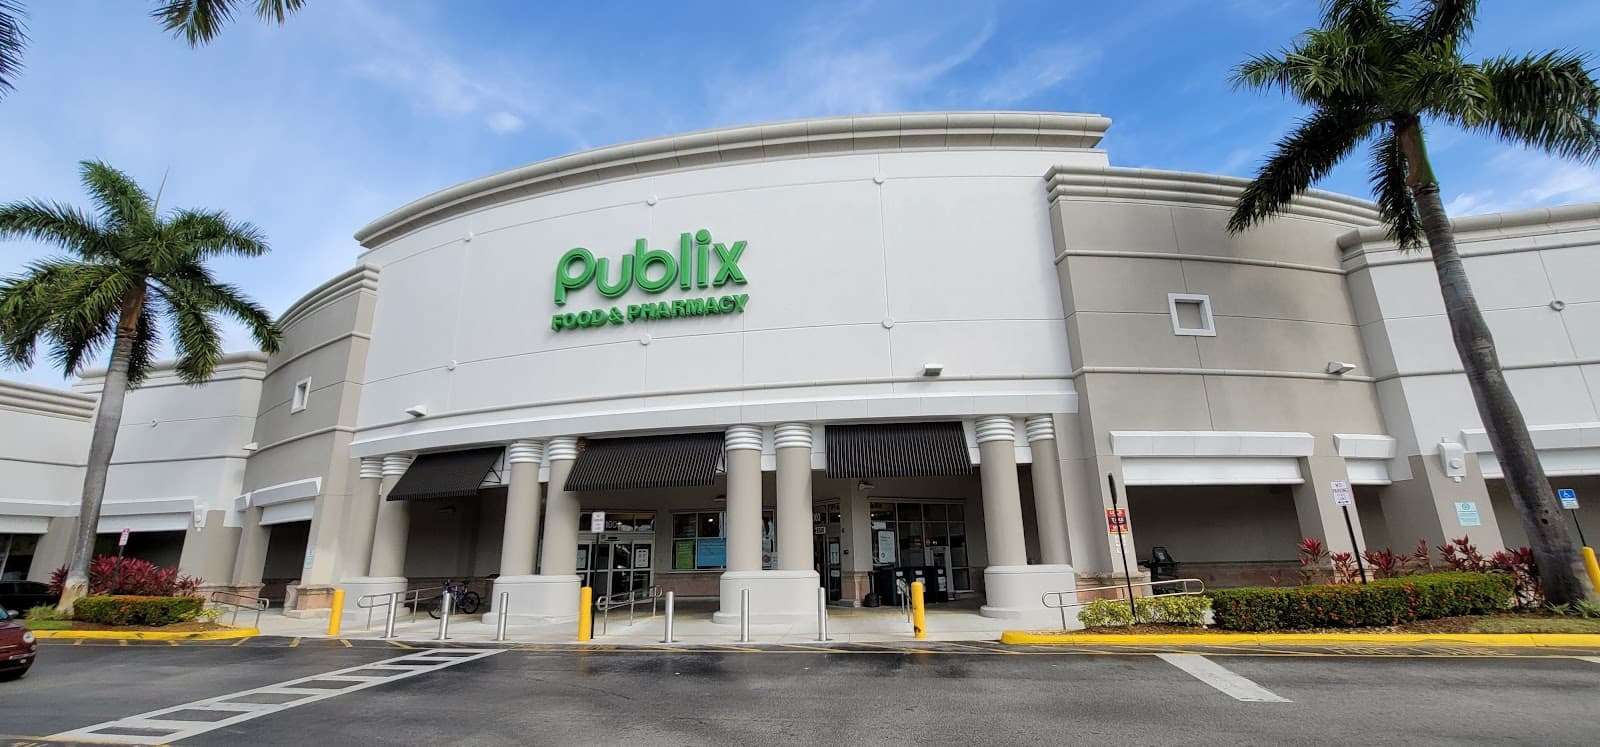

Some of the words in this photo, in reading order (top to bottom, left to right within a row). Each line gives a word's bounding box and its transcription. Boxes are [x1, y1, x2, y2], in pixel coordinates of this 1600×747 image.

[554, 229, 748, 306] Publix
[551, 308, 609, 332] FOOD
[609, 307, 624, 324] &
[627, 294, 749, 323] PHARMACY
